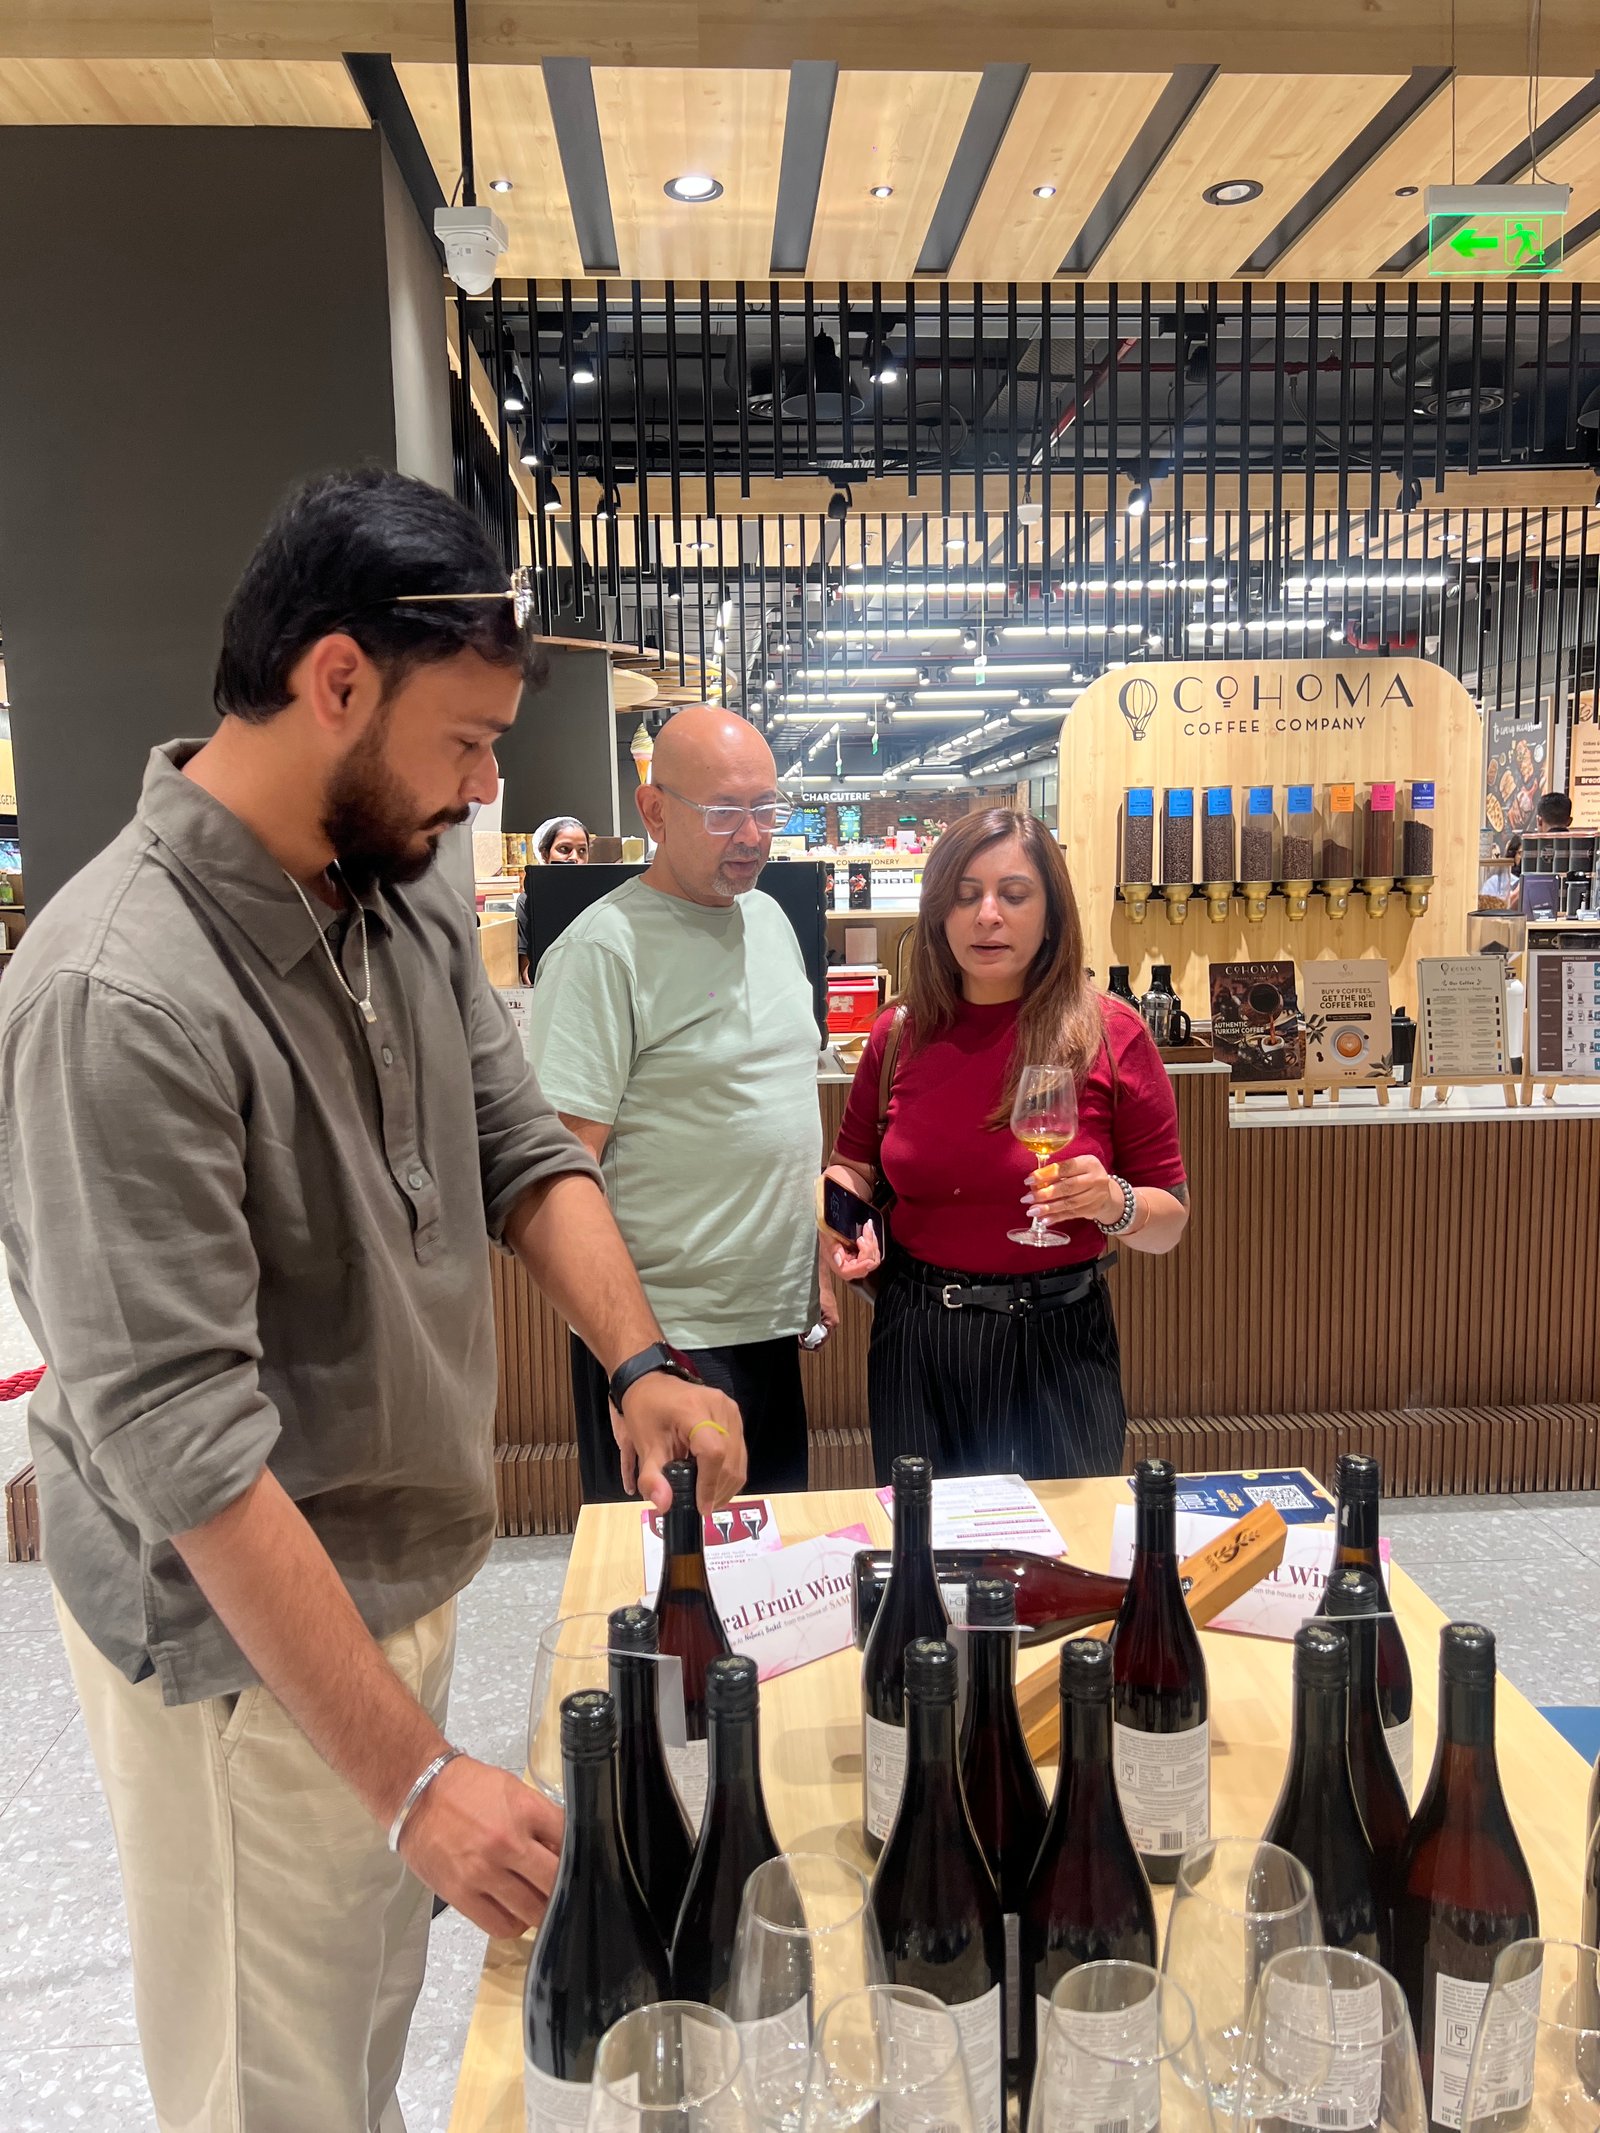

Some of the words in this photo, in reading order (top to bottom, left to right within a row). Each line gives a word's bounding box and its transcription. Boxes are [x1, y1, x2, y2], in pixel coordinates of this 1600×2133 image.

[1173, 673, 1414, 713] COHOMA
[1184, 720, 1260, 736] COFFEE
[1276, 717, 1366, 732] COMPANY
[802, 792, 871, 802] CHARCUTERIE
[1225, 964, 1279, 976] COHOMA
[1321, 994, 1337, 1002] GET
[1320, 1001, 1351, 1009] COFFEE
[1214, 1021, 1248, 1029] AUTHENTIC
[1240, 1026, 1265, 1034] COFFEE
[1264, 1588, 1275, 1596] the
[1276, 1589, 1297, 1599] house
[752, 1587, 806, 1622] Fruit
